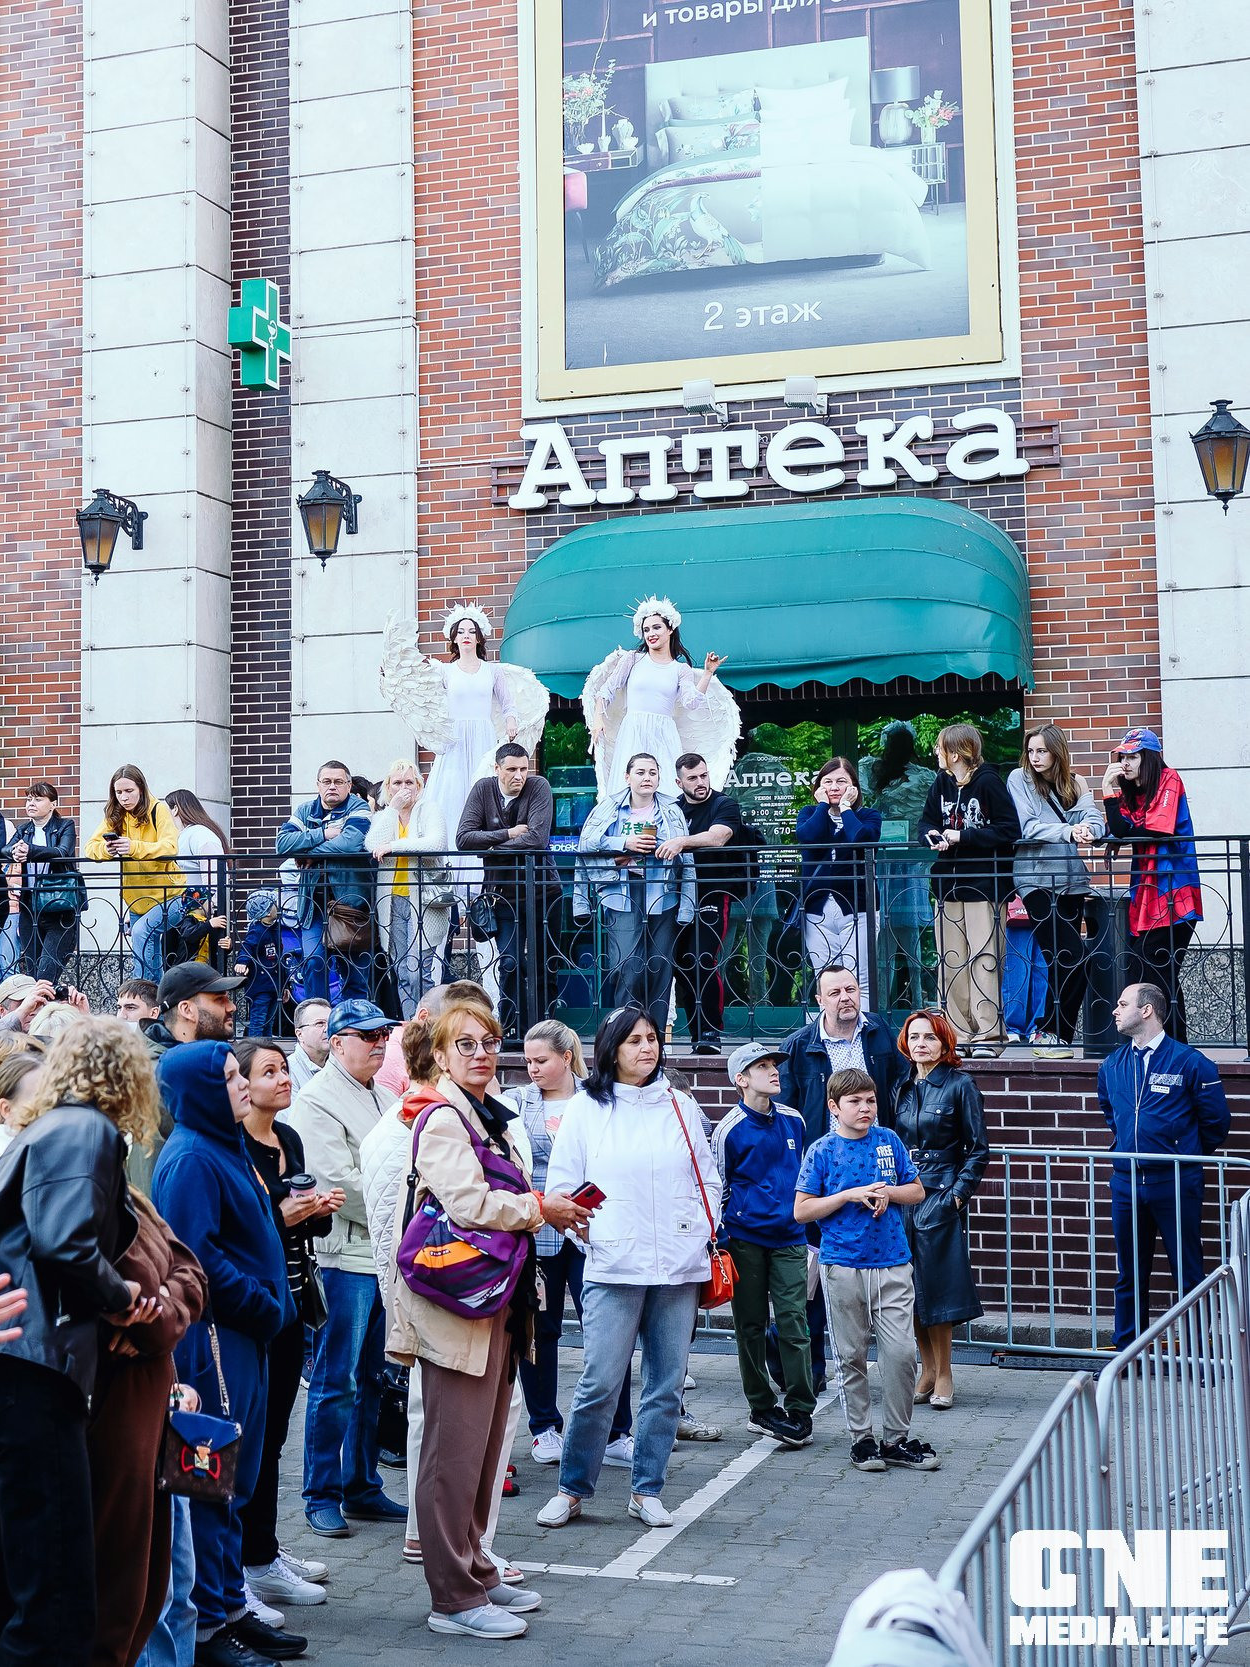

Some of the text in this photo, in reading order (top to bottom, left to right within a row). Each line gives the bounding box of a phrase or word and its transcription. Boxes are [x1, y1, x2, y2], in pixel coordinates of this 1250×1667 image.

[642, 11, 658, 28] и
[665, 0, 763, 25] товары
[703, 298, 823, 331] 2 этаж
[508, 407, 1031, 510] Аптека
[876, 1144, 894, 1157] FREE
